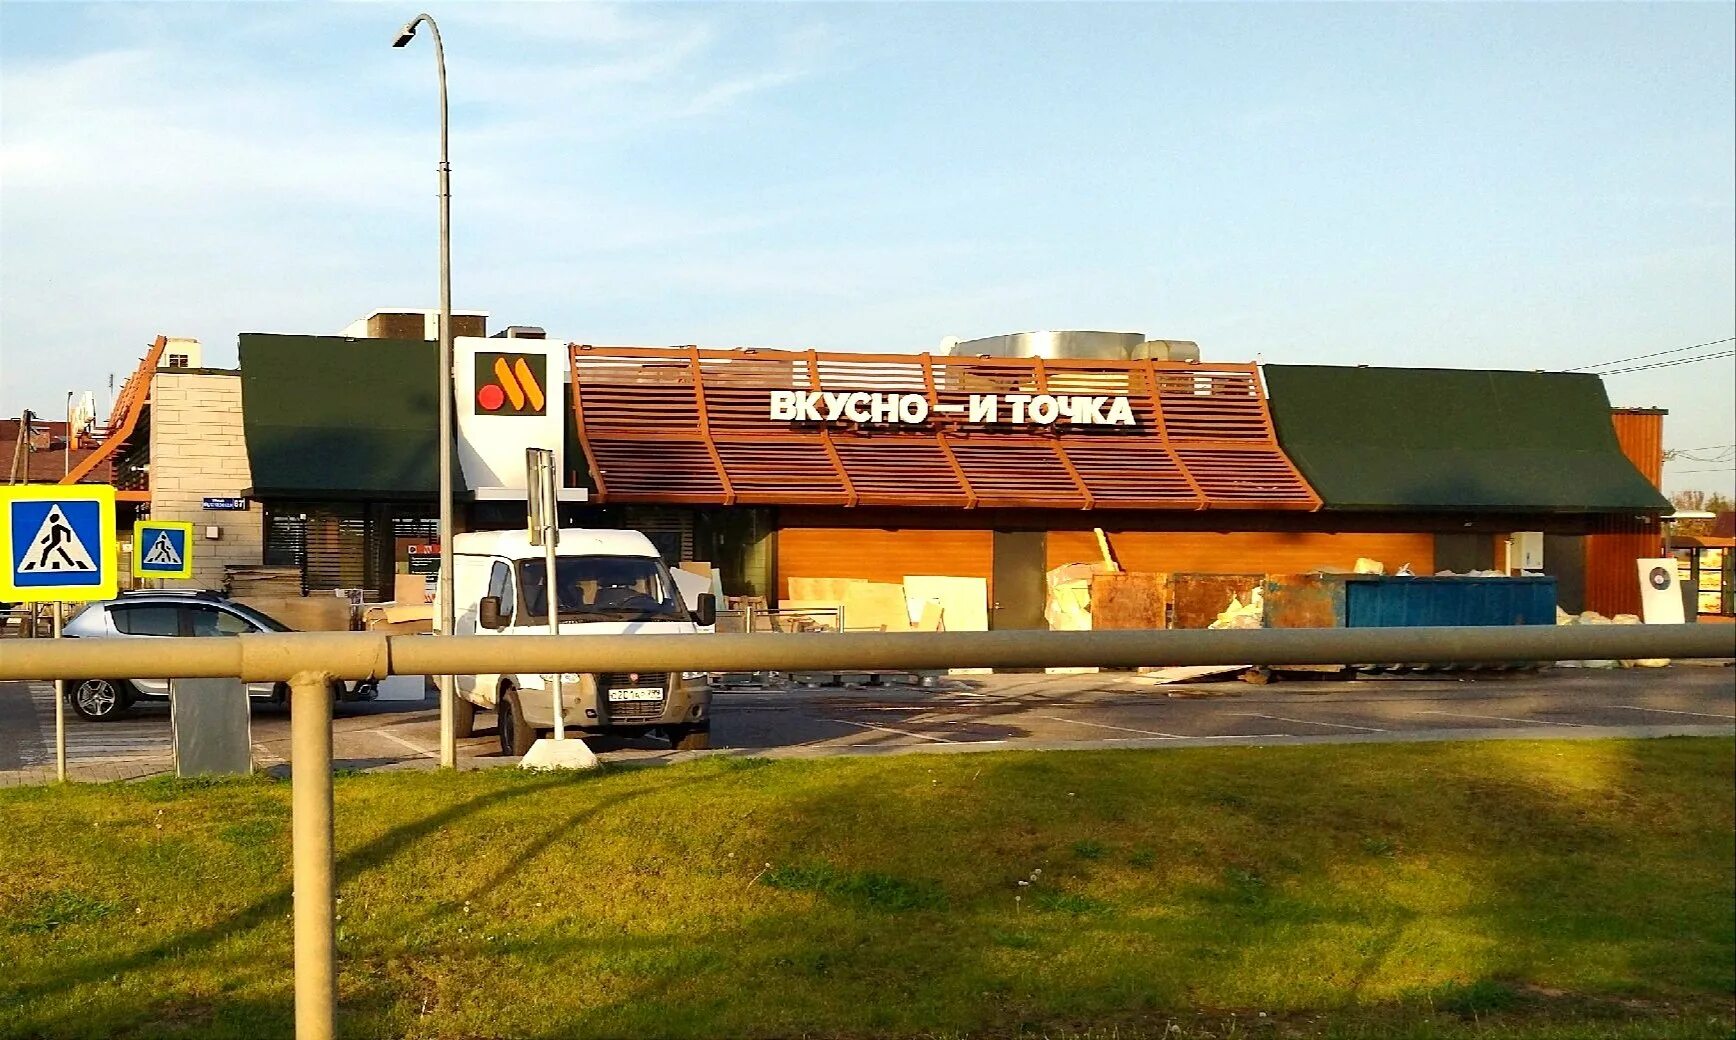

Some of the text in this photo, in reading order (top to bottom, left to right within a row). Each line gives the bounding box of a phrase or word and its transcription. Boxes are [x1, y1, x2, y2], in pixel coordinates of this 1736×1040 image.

[770, 391, 928, 424] ВКУСНО
[969, 395, 998, 423] И
[1004, 395, 1136, 426] ТОЧКА
